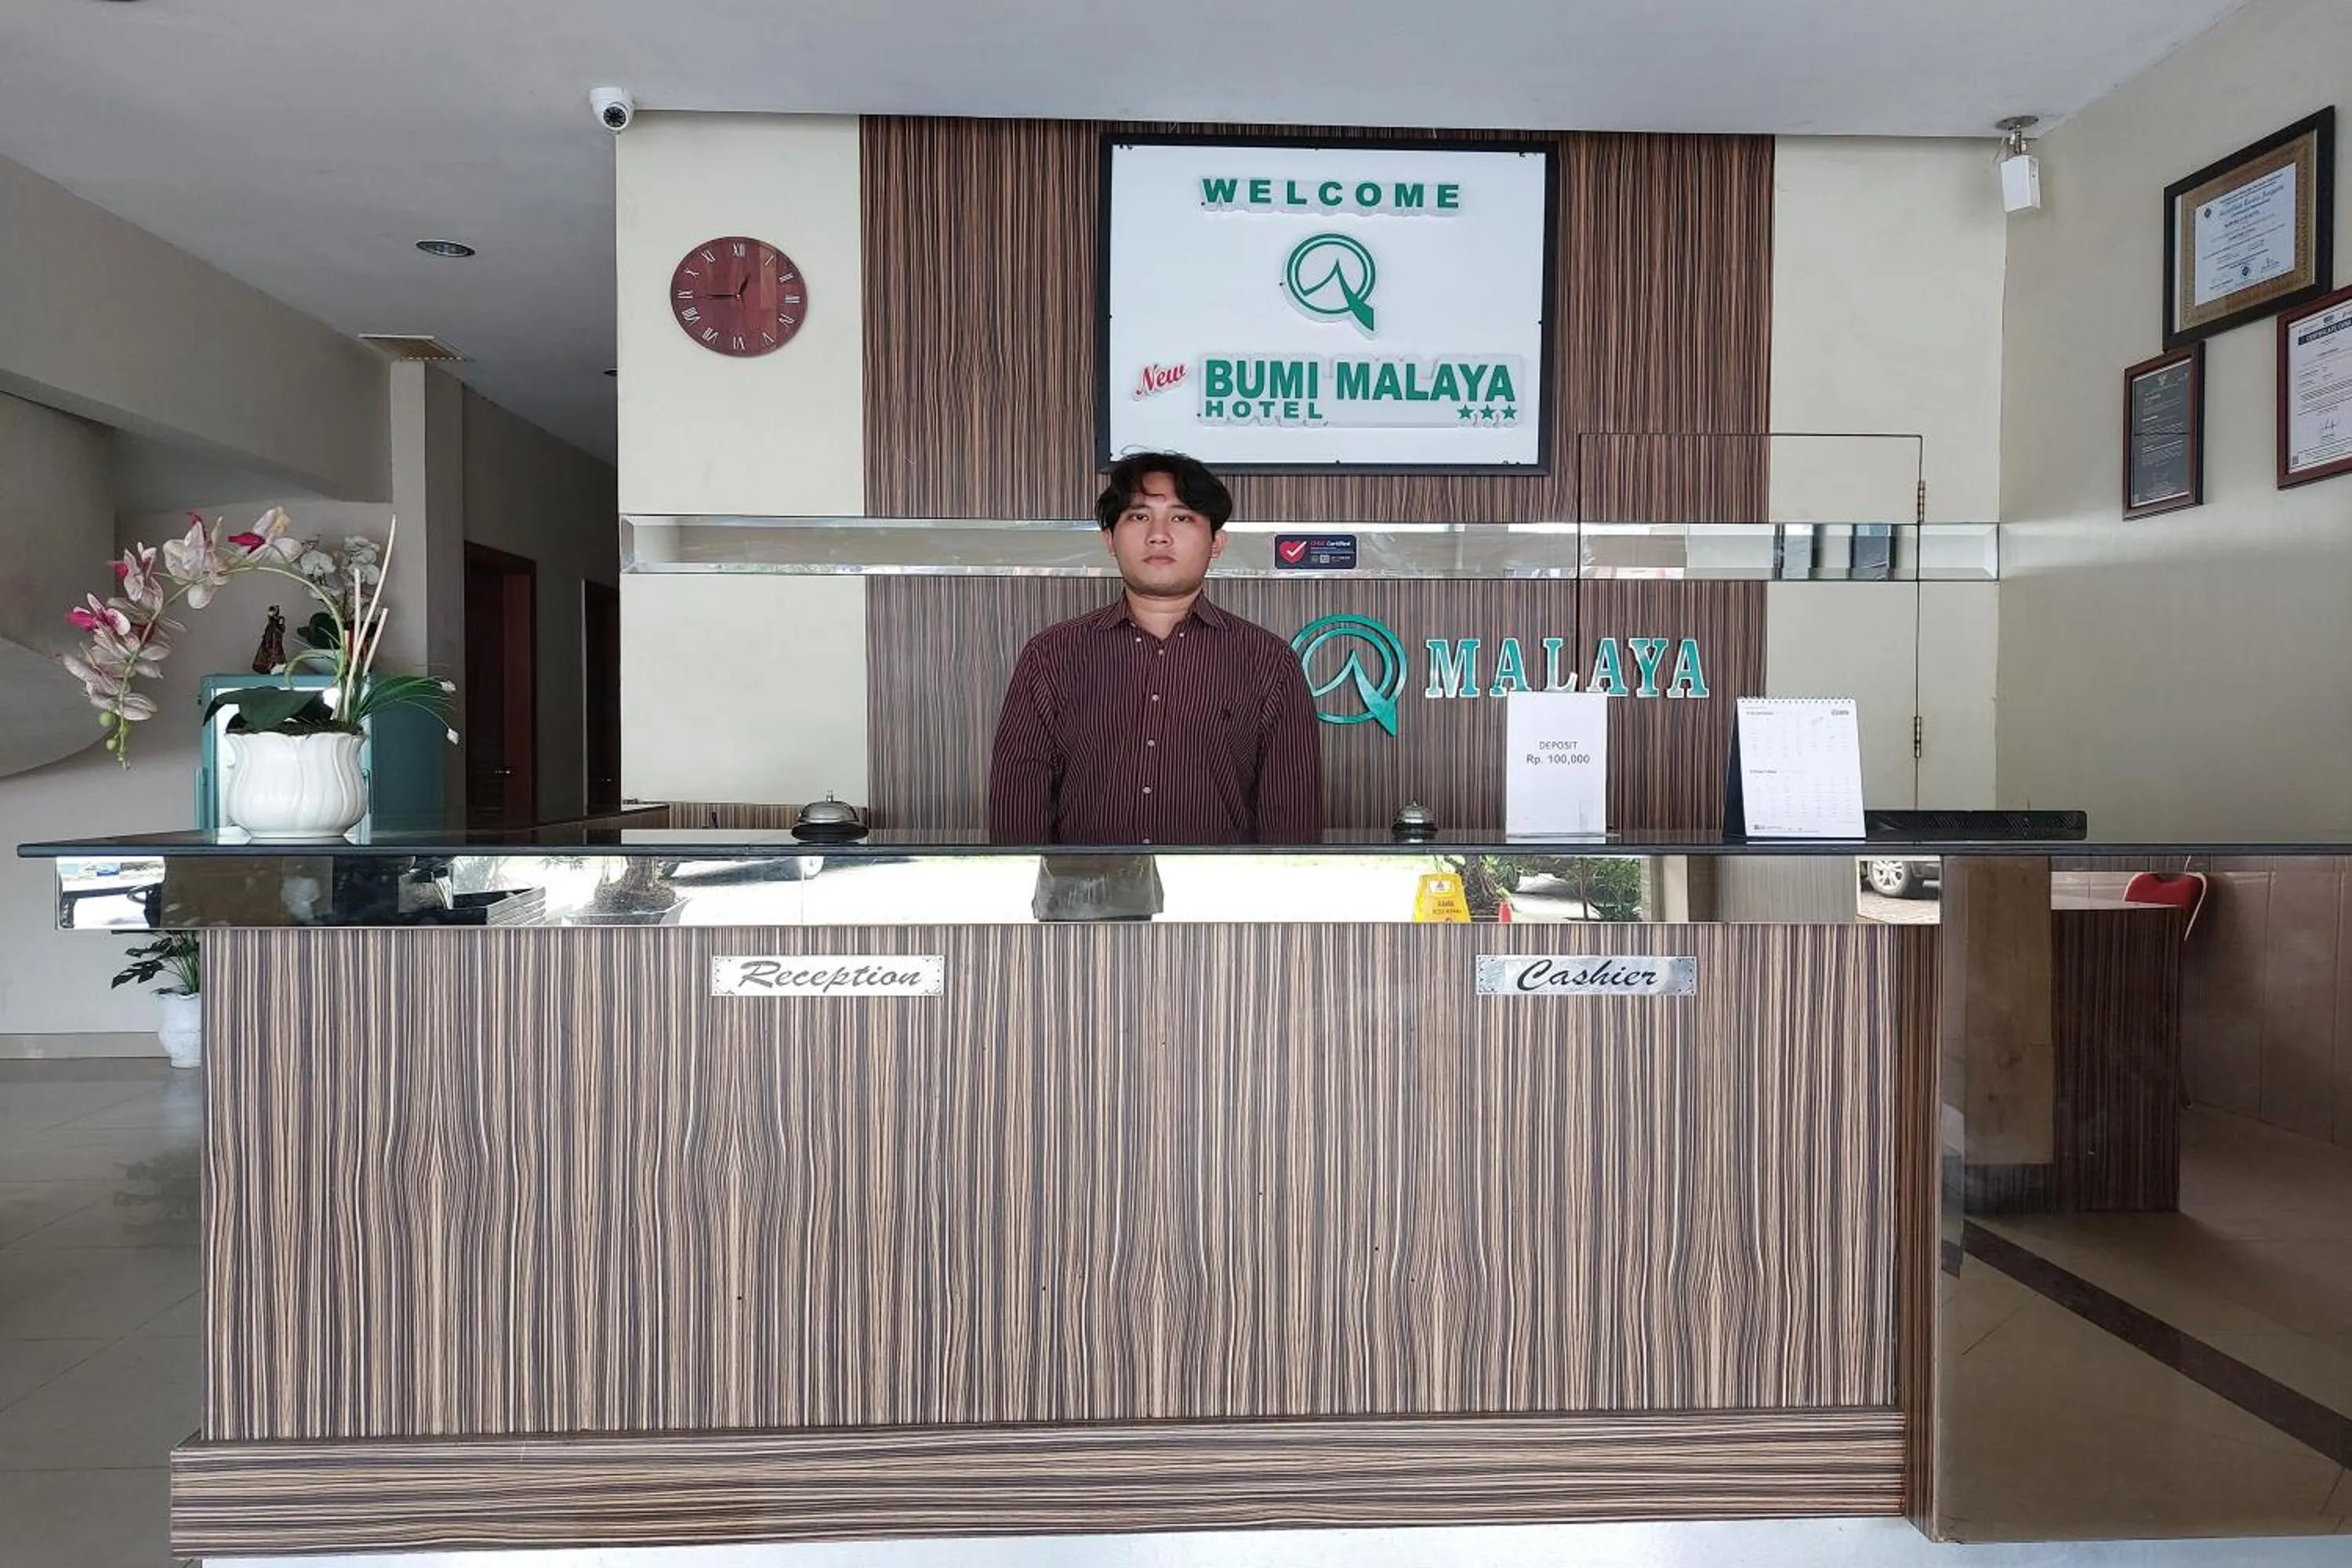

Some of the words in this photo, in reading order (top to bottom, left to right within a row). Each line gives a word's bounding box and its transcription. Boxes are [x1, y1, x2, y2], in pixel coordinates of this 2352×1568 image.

[1202, 178, 1460, 209] WELCOME
[1135, 363, 1186, 396] New
[1205, 359, 1319, 399] BUMI
[1336, 361, 1516, 402] MALAYA
[1205, 401, 1323, 419] HOTEL
[1425, 637, 1710, 699] MALAYA
[1526, 753, 1544, 765] Rp.
[1548, 753, 1591, 765] 100,000
[1538, 741, 1578, 750] DEPOSIT
[738, 960, 922, 993] Reception
[1517, 959, 1659, 991] Cashier
